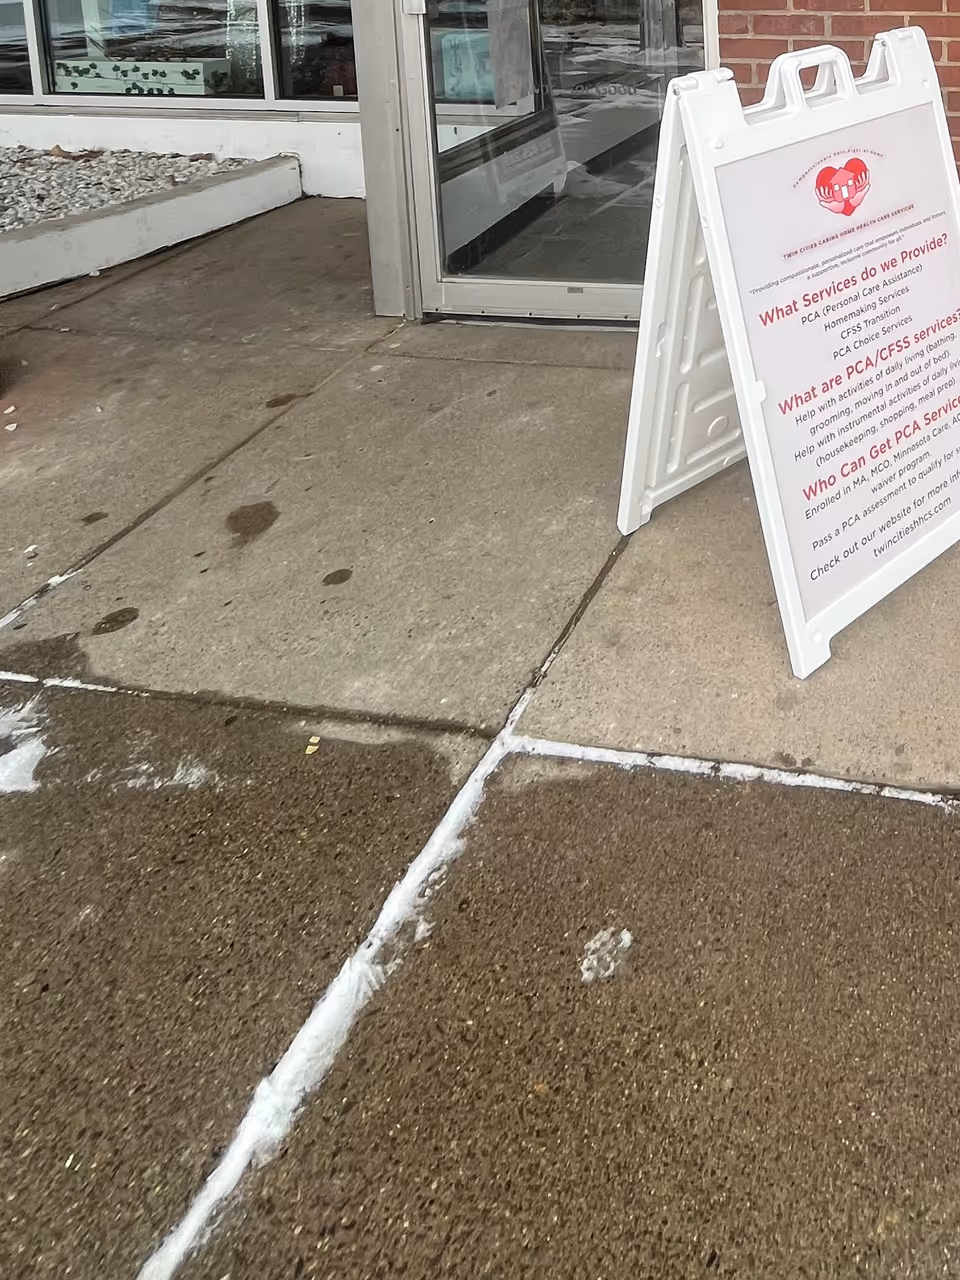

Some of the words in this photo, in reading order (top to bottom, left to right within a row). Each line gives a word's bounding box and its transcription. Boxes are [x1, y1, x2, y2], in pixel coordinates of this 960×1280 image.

[758, 299, 798, 326] What
[802, 275, 857, 307] Services
[860, 266, 876, 281] do
[879, 257, 897, 272] we
[900, 232, 947, 263] Provide?
[800, 310, 820, 325] PCA
[822, 290, 860, 316] (Personal
[861, 283, 880, 296] Care
[882, 263, 922, 288] Assistance)
[823, 301, 877, 332] Homemaking
[877, 285, 909, 305] Services
[832, 345, 852, 360] PCA
[853, 331, 880, 349] Choice
[881, 315, 912, 335] Services
[840, 322, 862, 339] CFSS
[862, 305, 900, 328] Transition
[777, 385, 817, 414] What
[821, 374, 842, 393] are
[845, 335, 910, 380] PCA/CFSS
[793, 444, 815, 461] Help
[816, 431, 835, 447] with
[836, 400, 887, 436] instrumental
[888, 382, 921, 406] activities
[922, 374, 929, 386] of
[931, 366, 948, 380] daily
[794, 409, 816, 425] Help
[817, 397, 836, 412] with
[837, 376, 874, 401] activities
[875, 368, 883, 380] of
[884, 360, 902, 375] daily
[904, 348, 924, 364] living
[809, 406, 853, 436] grooming,
[854, 387, 883, 410] moving
[884, 382, 892, 391] in
[894, 371, 908, 387] and
[909, 364, 922, 377] out
[923, 358, 931, 369] of
[802, 474, 836, 501] Who
[840, 455, 866, 477] Can
[869, 437, 892, 459] Get
[894, 419, 921, 444] PCA
[815, 425, 878, 467] (housekeeping,
[879, 402, 917, 428] shopping,
[917, 387, 935, 405] meal
[804, 489, 841, 519] Enrolled
[842, 485, 851, 495] in
[852, 474, 869, 489] MA,
[870, 459, 892, 477] MCO,
[892, 434, 931, 462] Minnesota
[812, 532, 832, 551] Pass
[834, 528, 840, 536] a
[841, 513, 860, 531] PCA
[862, 481, 907, 517] assessment
[907, 476, 916, 486] to
[917, 458, 942, 479] qualify
[943, 450, 953, 462] for
[870, 472, 896, 494] waiver
[897, 451, 931, 478] program.
[810, 554, 841, 580] Check
[842, 541, 859, 558] out
[860, 529, 876, 545] our
[878, 505, 911, 533] website
[912, 495, 925, 509] for
[926, 480, 948, 499] more
[873, 496, 951, 557] twincitieshhcs.com
